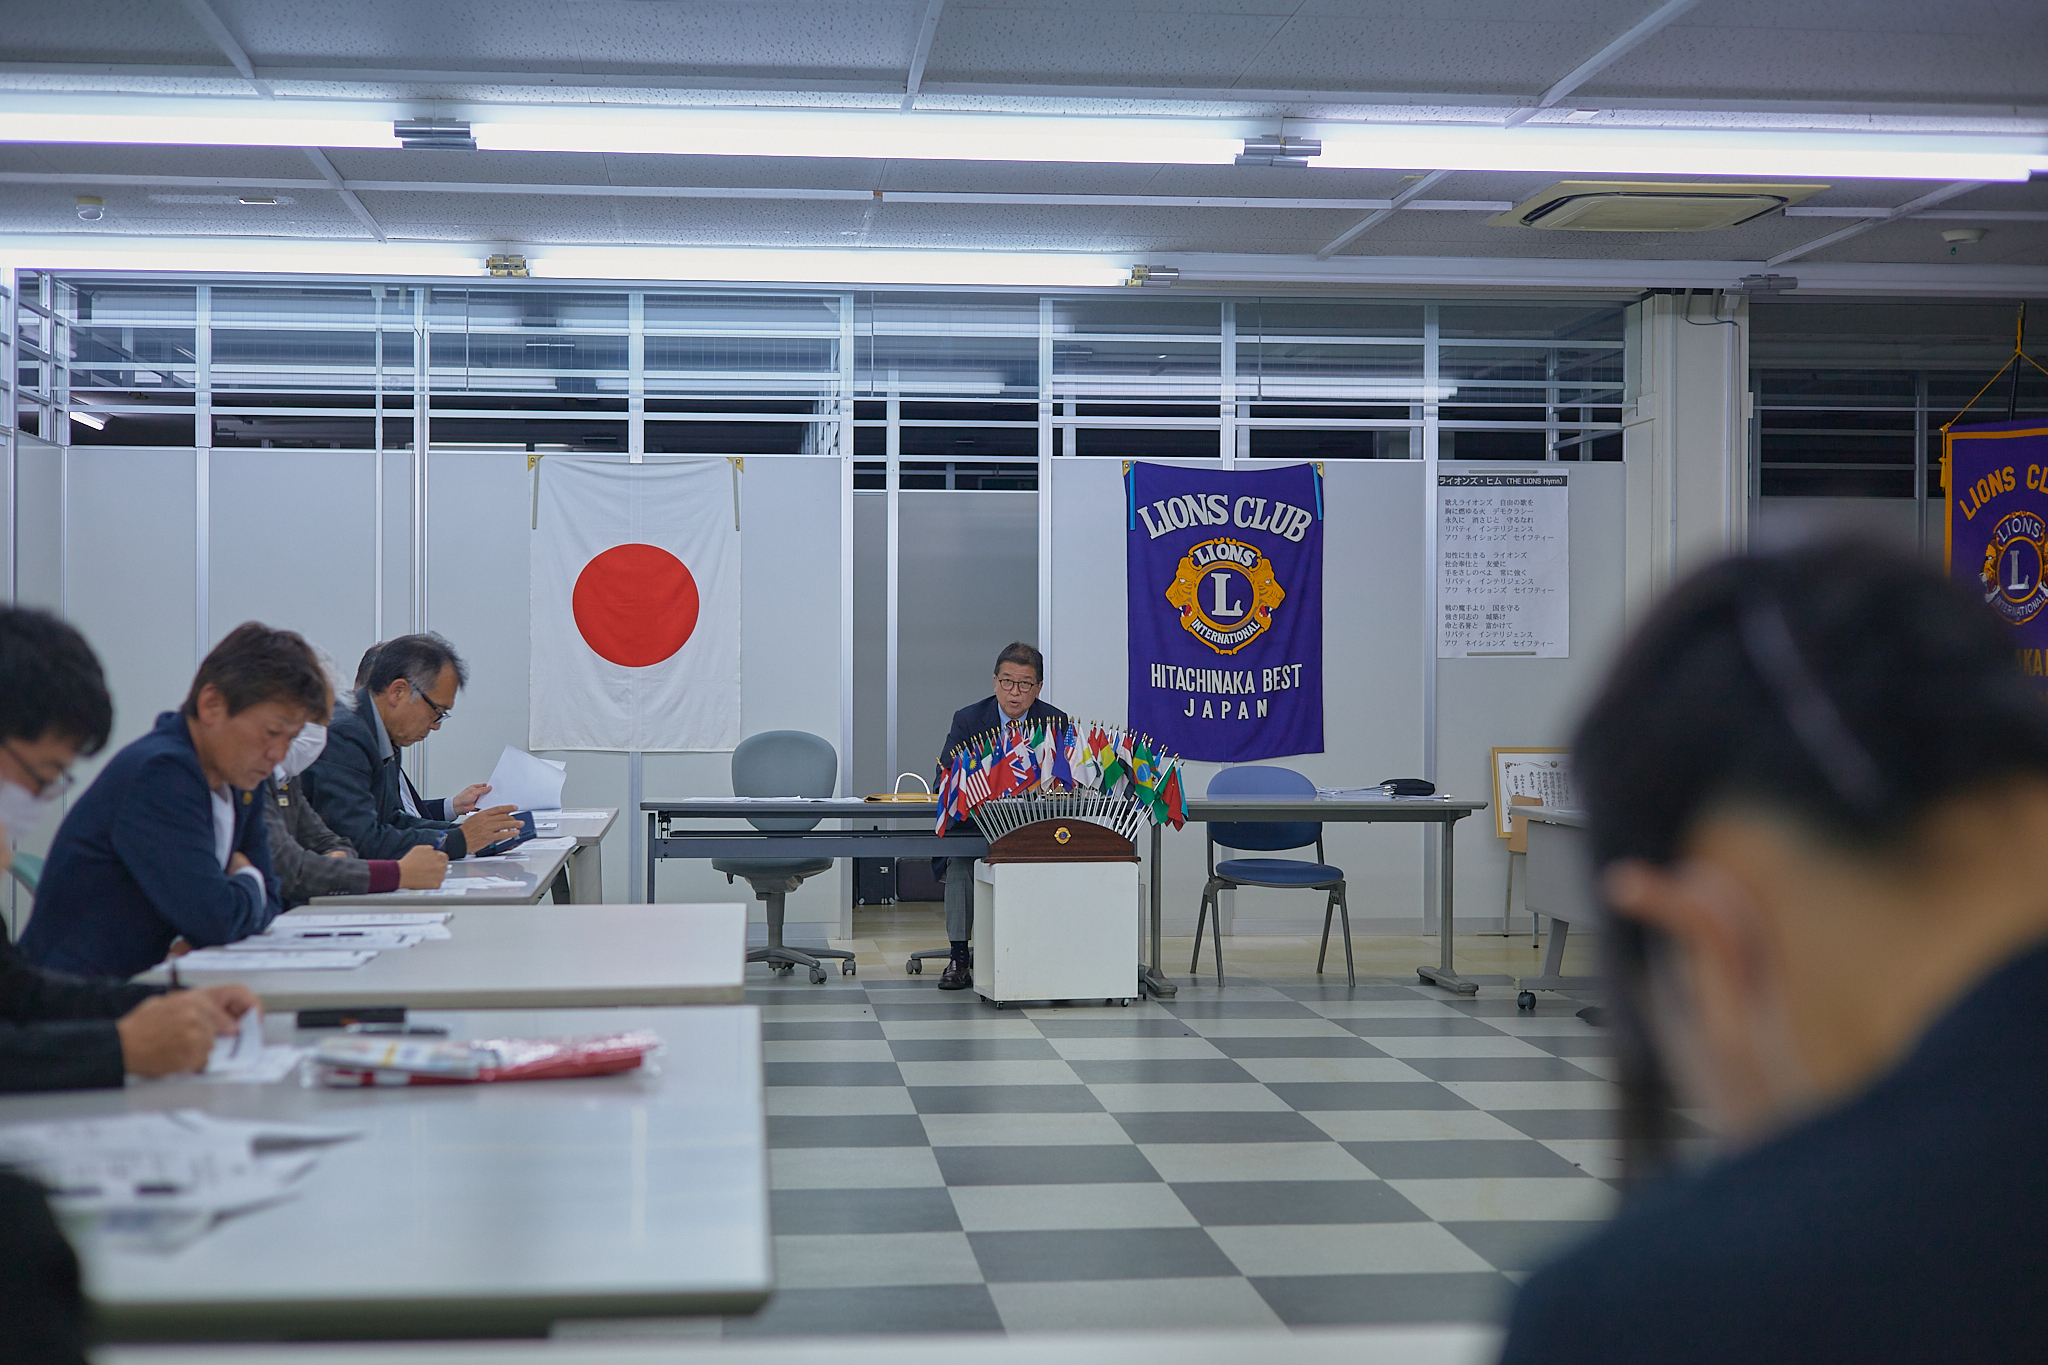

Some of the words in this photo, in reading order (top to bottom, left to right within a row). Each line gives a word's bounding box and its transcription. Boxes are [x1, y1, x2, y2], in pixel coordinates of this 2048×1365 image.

[1439, 476, 1502, 486] ライオンズ・ヒム
[1523, 477, 1541, 485] LIONS
[1959, 466, 2016, 521] LIONS
[1137, 493, 1229, 540] LIONS
[1233, 495, 1313, 543] CLUB
[1445, 507, 1486, 515] 胸に燃ゆる火
[1493, 507, 1534, 515] デモクラシー
[1445, 516, 1465, 524] 永久に
[1472, 516, 1499, 524] 消さじと
[1507, 516, 1534, 524] 守るなれ
[1479, 525, 1534, 533] インテリジェンス
[1997, 517, 2042, 543] LIONS
[1193, 543, 1257, 567] LIONS
[1445, 551, 1486, 559] 知性に生きる
[1493, 551, 1528, 559] ライオンズ
[1445, 560, 1479, 568] 社会奉仕と
[1486, 560, 1506, 568] 友愛に
[1500, 569, 1527, 577] 常に強く
[2008, 550, 2030, 590] L
[1210, 572, 1244, 617] L
[1994, 593, 2046, 617] INTERNATIONAL
[1445, 613, 1479, 621] 強き同志の
[1492, 604, 1520, 612] 国を守る
[1191, 620, 1261, 645] INTERNATIONAL
[1150, 663, 1256, 695] HITACHINAKA
[1262, 663, 1303, 692] BEST
[1184, 698, 1268, 720] JAPAN
